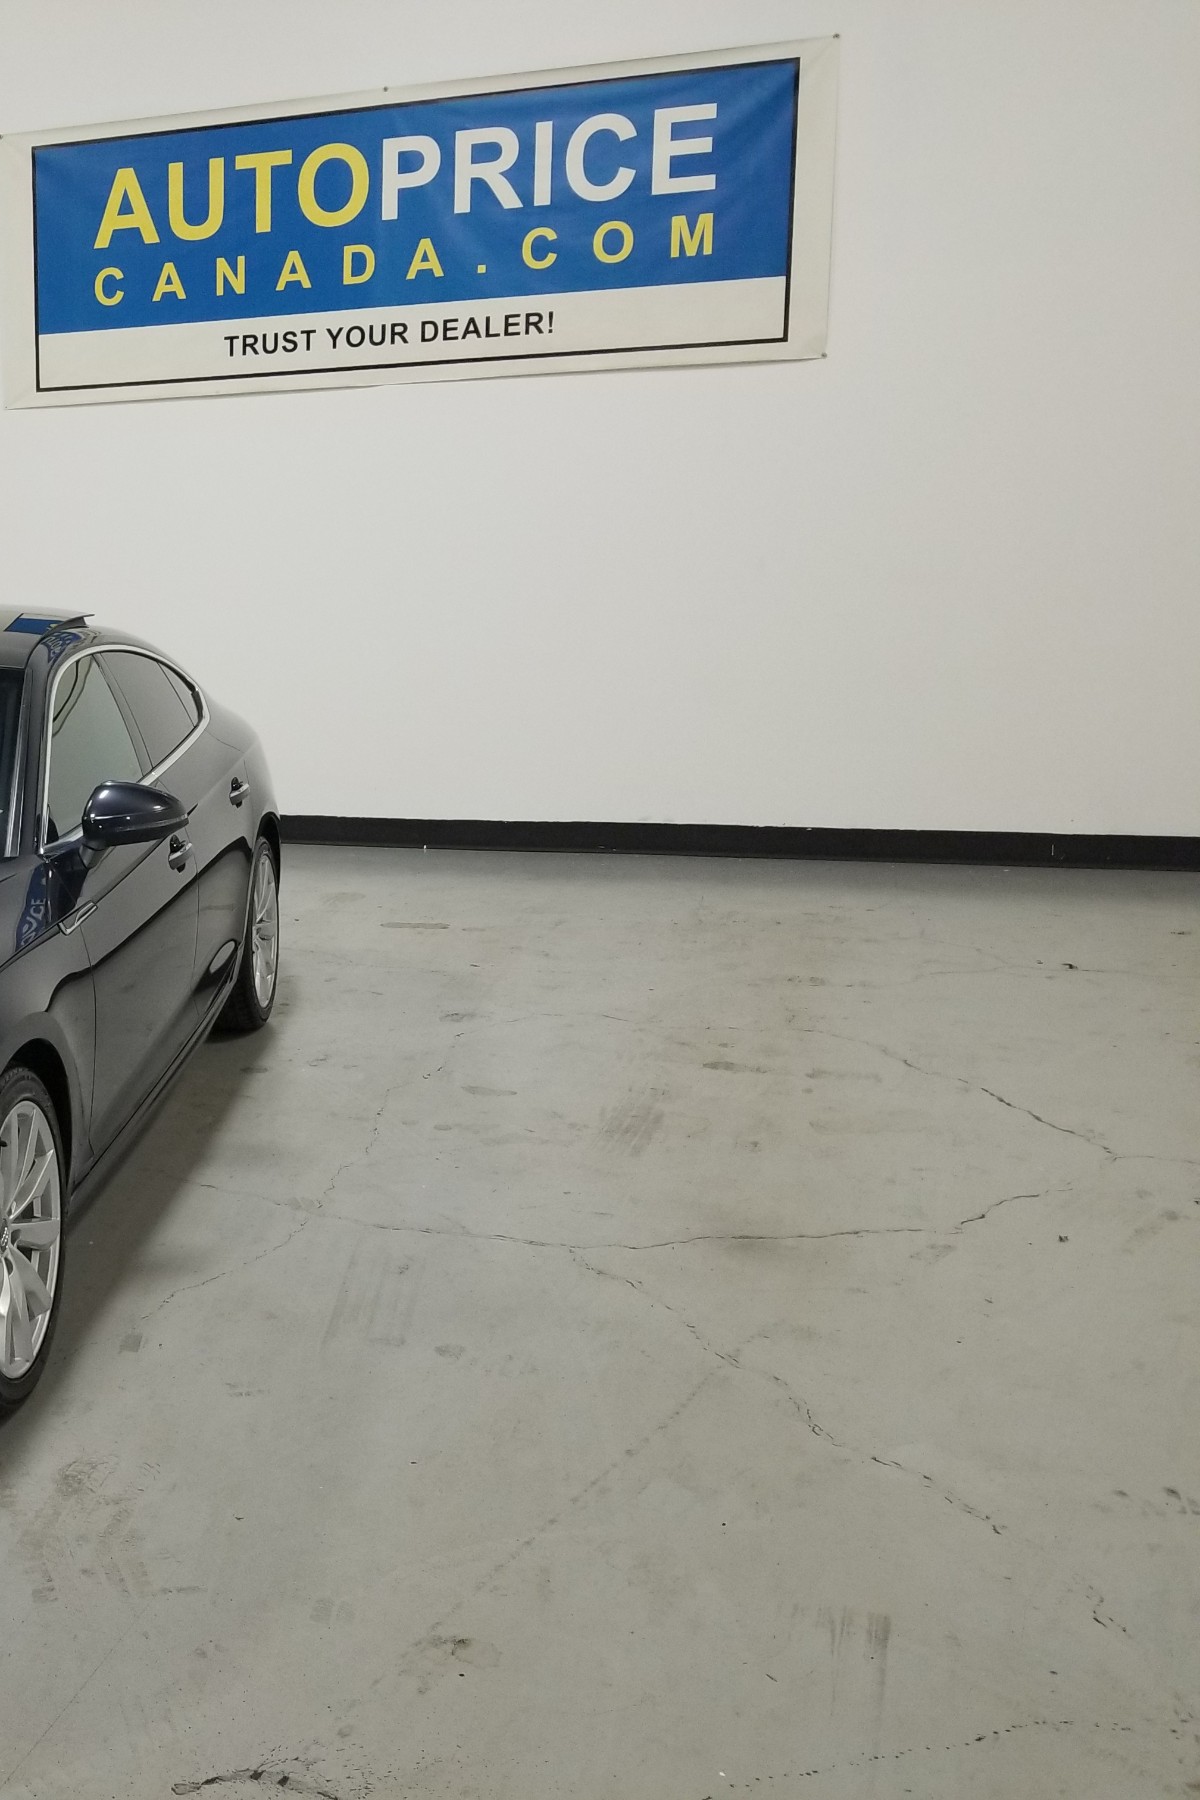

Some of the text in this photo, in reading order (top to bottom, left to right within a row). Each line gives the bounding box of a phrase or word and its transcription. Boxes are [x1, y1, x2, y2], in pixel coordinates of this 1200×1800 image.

[93, 102, 718, 250] AUTOPRICE
[93, 212, 714, 306] CANADA.COM
[224, 311, 555, 357] TRUST YOUR DEALER!
